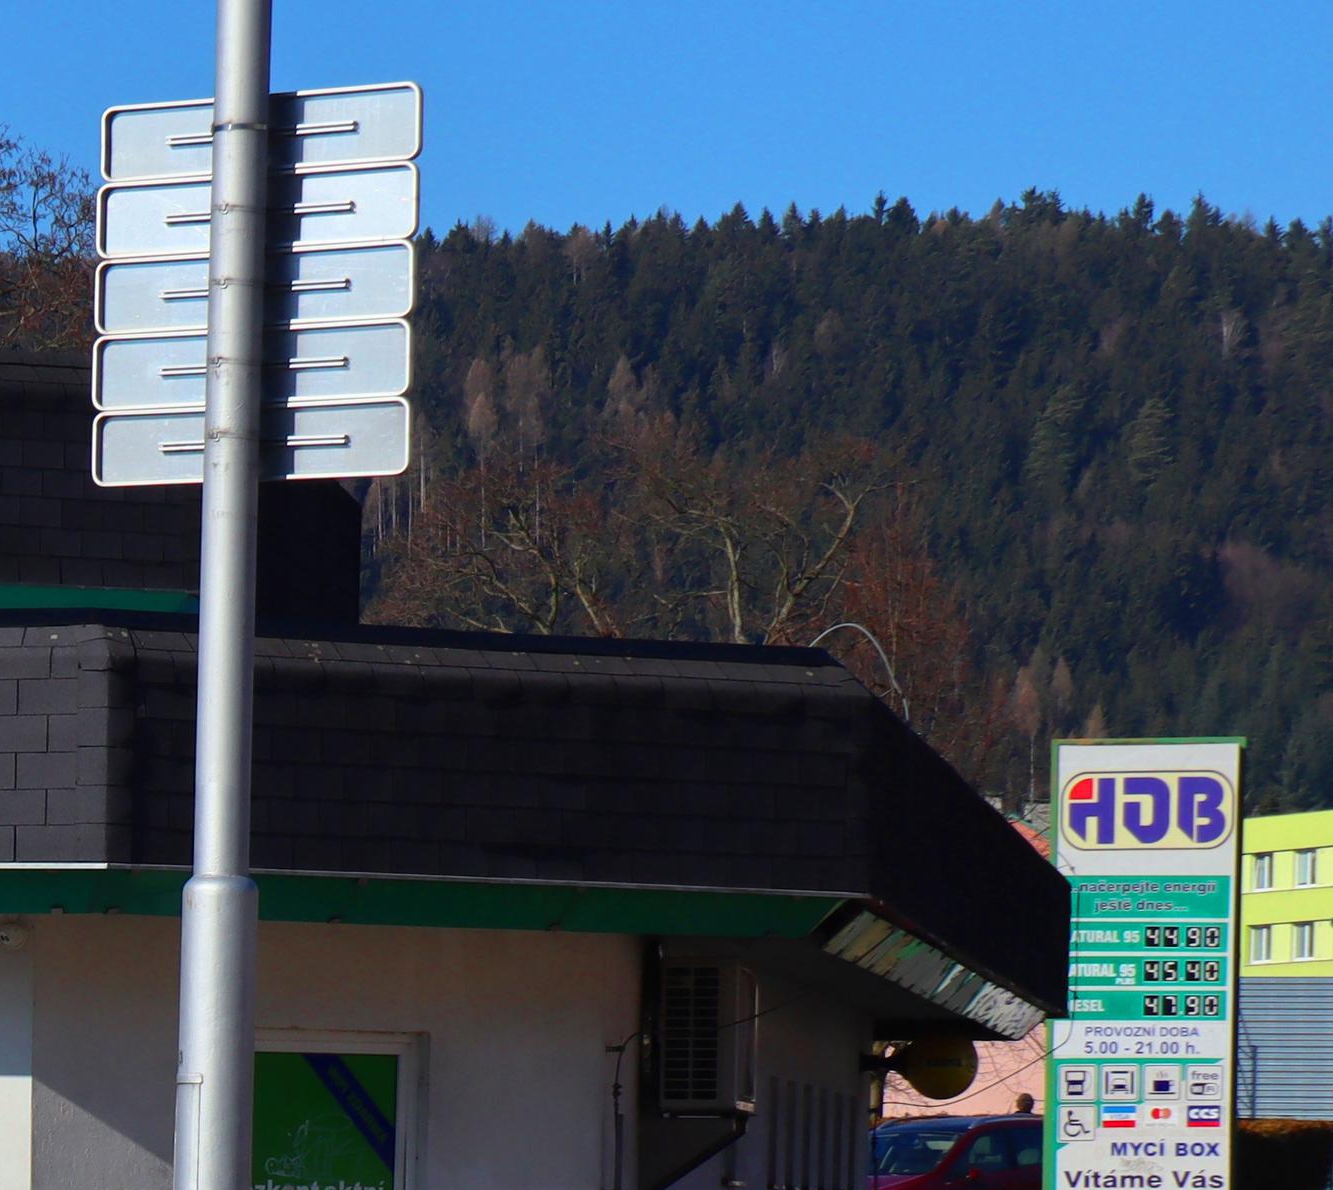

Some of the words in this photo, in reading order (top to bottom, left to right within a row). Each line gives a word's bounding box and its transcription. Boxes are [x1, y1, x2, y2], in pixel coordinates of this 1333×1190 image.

[1164, 880, 1217, 895] energii
[1070, 930, 1120, 943] ATURAL
[1123, 930, 1140, 943] 95
[1069, 963, 1117, 977] ATURAL
[1119, 963, 1136, 977] 95
[1069, 999, 1105, 1012] IESEL
[1084, 1024, 1156, 1037] PROVOZNÍ
[1159, 1026, 1200, 1037] DOBA
[1084, 1041, 1118, 1054] 5.00
[1135, 1041, 1180, 1055] 21.00
[1191, 1070, 1219, 1080] free
[1188, 1107, 1219, 1119] CCS
[1110, 1139, 1165, 1157] MYCÍ
[1175, 1142, 1220, 1157] BOX
[1064, 1169, 1162, 1189] Vítáme
[1172, 1169, 1224, 1189] Vás
